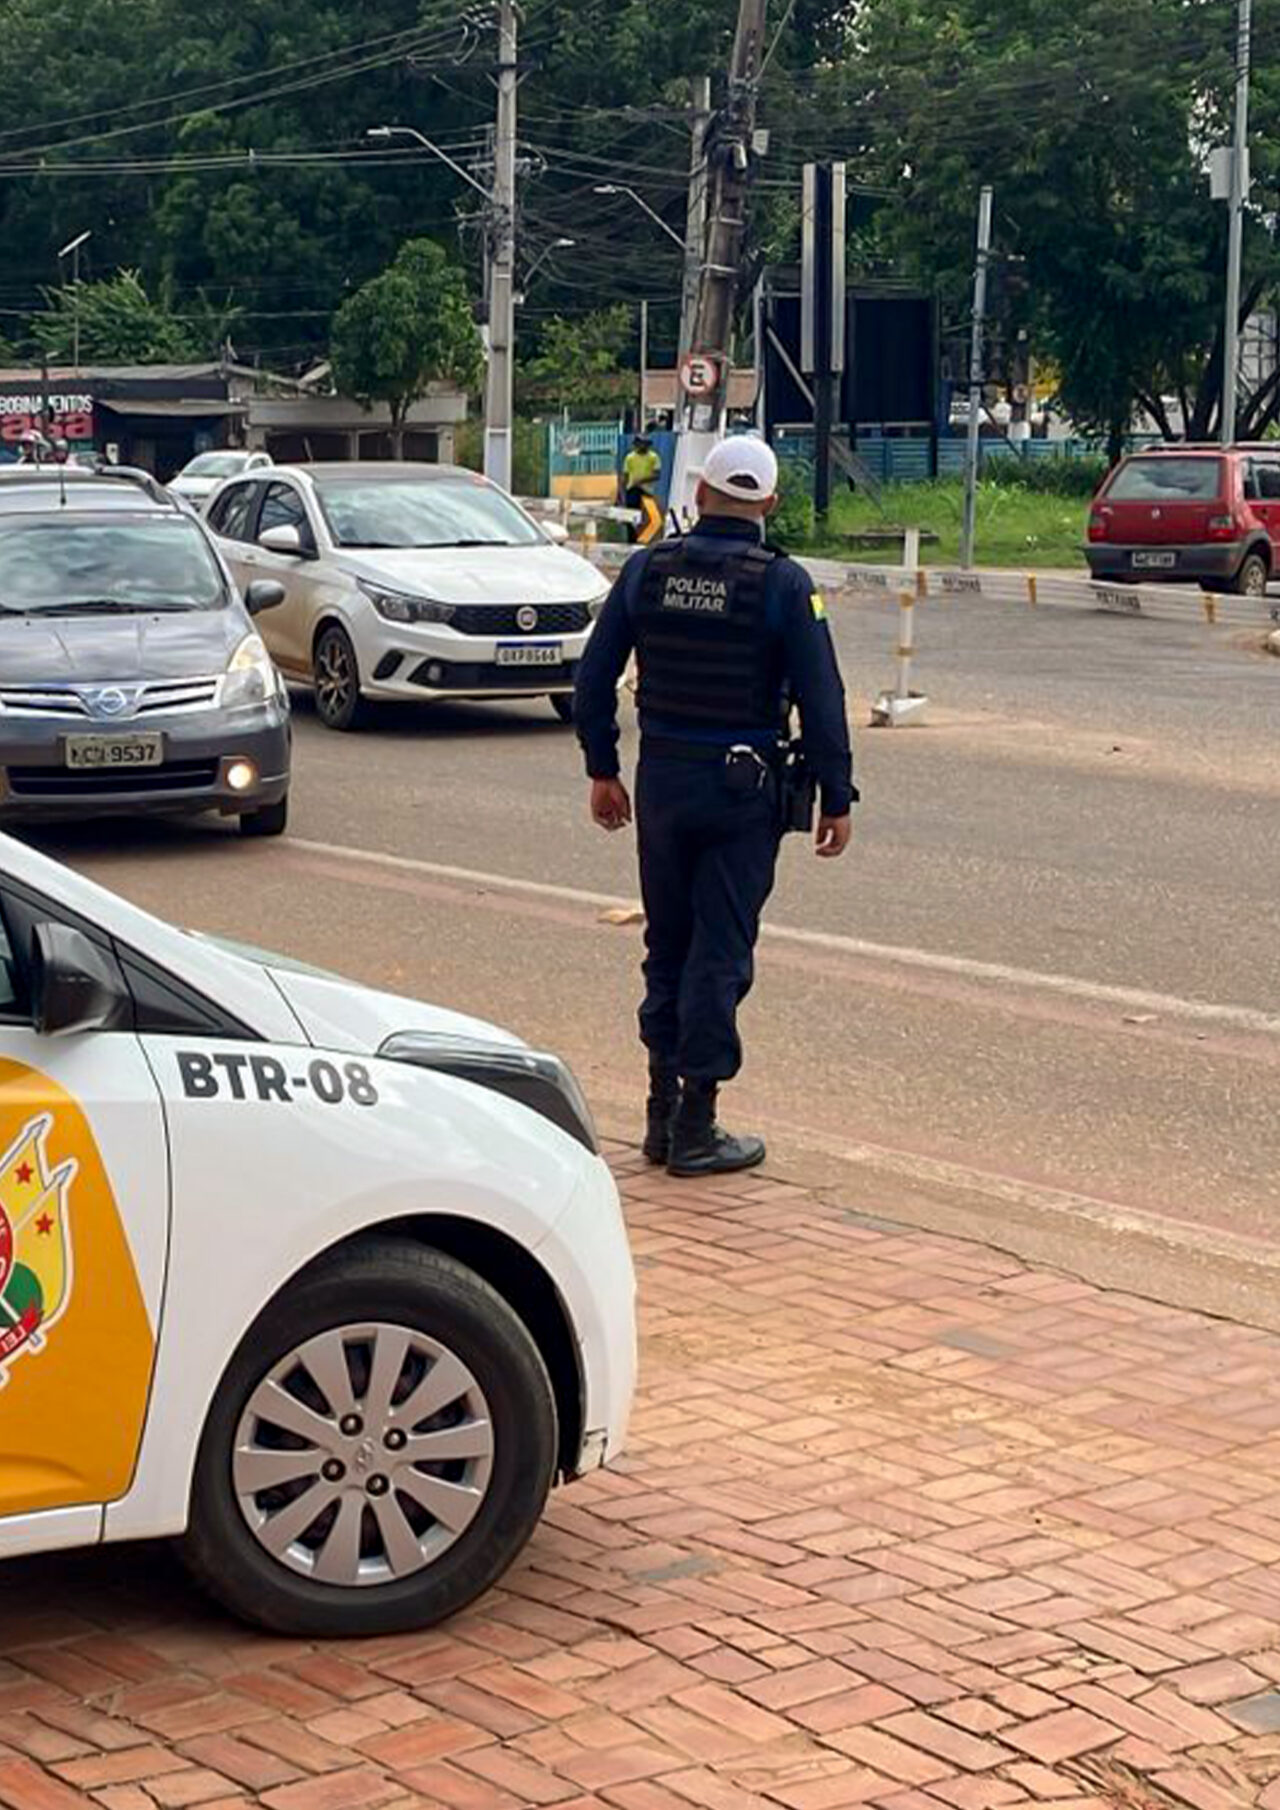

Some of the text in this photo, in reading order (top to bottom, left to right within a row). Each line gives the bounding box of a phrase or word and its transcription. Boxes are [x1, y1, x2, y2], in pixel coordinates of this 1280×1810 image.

[665, 576, 727, 597] POLÍCIA
[663, 593, 725, 612] MILITAR
[176, 1051, 379, 1107] BTR-08
